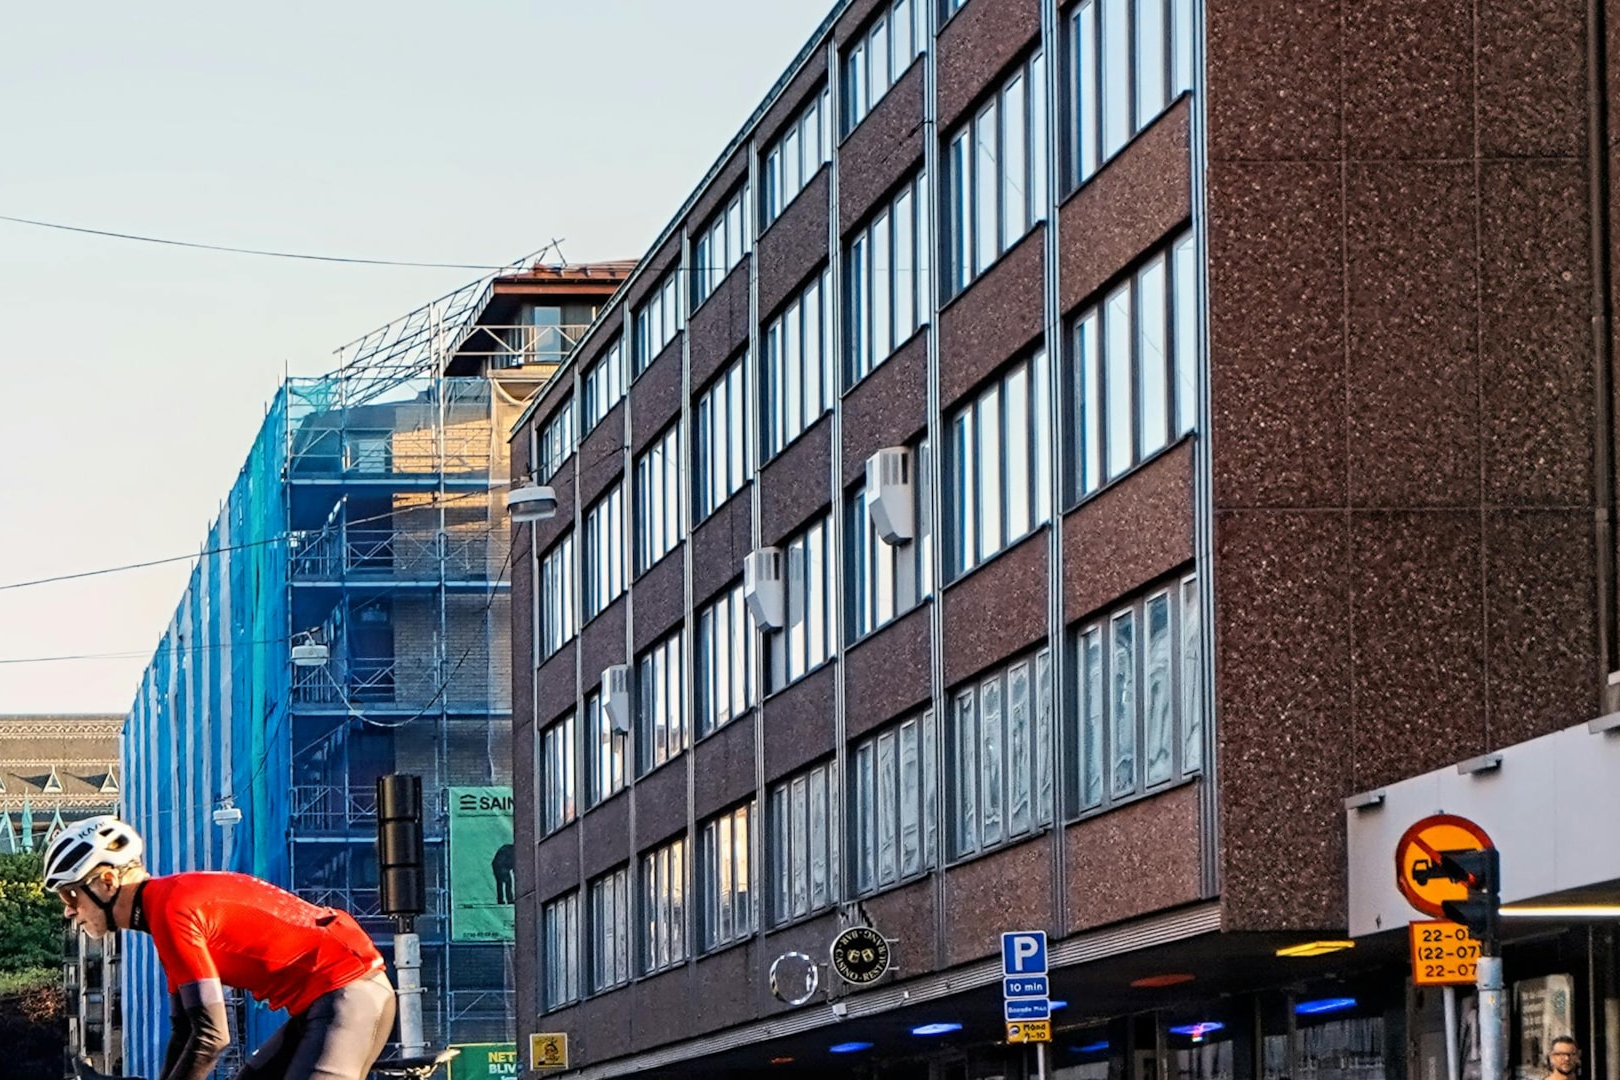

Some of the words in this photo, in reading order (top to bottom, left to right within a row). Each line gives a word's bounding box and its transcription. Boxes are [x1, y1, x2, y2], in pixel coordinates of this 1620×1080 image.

[840, 931, 859, 945] BAR
[1422, 928, 1468, 942] 22-0
[862, 930, 887, 981] RESTAURANG
[1013, 936, 1039, 971] P
[835, 948, 859, 980] CASINO
[1425, 964, 1477, 977] 22-07
[1010, 983, 1022, 992] 10
[1024, 982, 1043, 992] min
